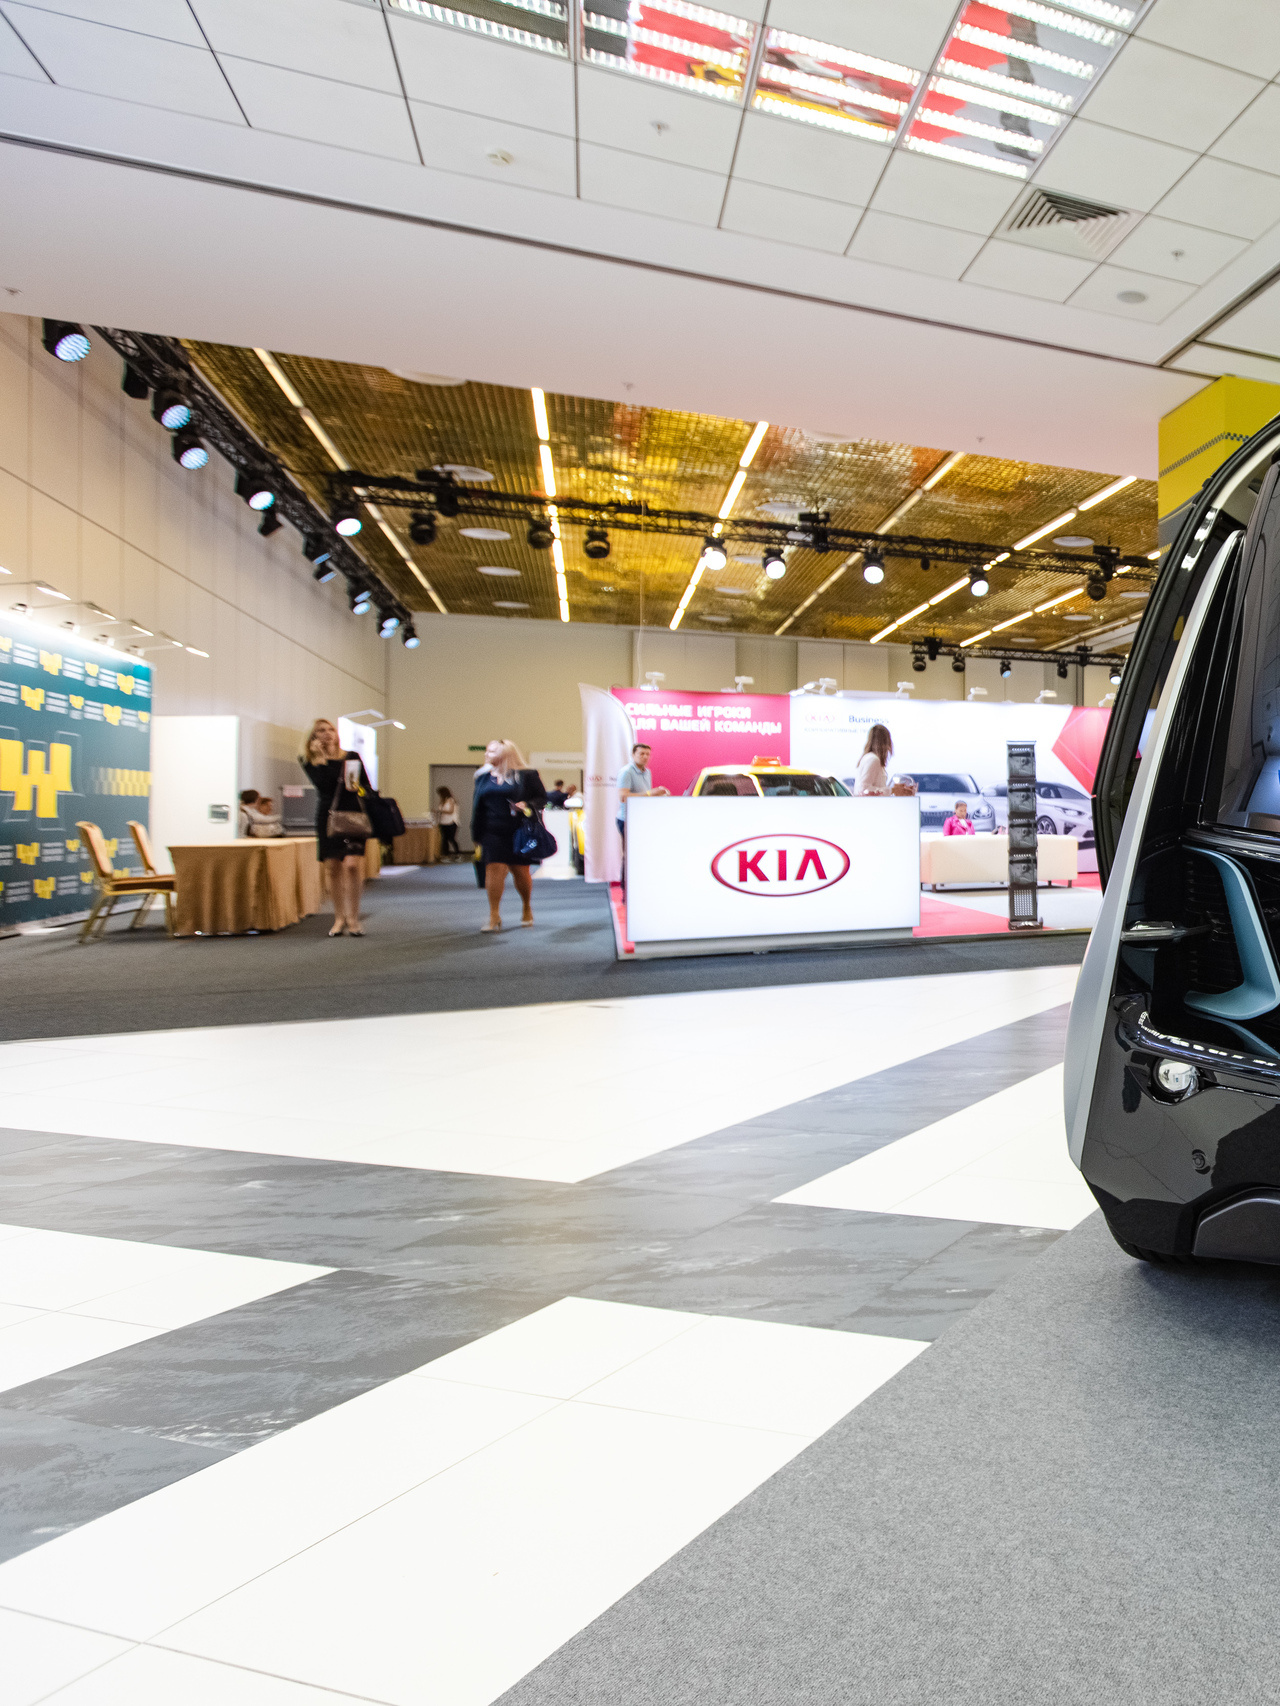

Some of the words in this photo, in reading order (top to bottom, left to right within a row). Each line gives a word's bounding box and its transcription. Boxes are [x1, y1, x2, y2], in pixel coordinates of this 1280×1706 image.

[625, 702, 692, 717] СИЛЬНЫЕ
[697, 705, 751, 719] ИГРОКИ
[660, 718, 710, 732] ВАШЕЙ
[715, 721, 782, 736] КОМАНДЫ
[849, 715, 889, 724] Business
[736, 848, 828, 883] KIA
